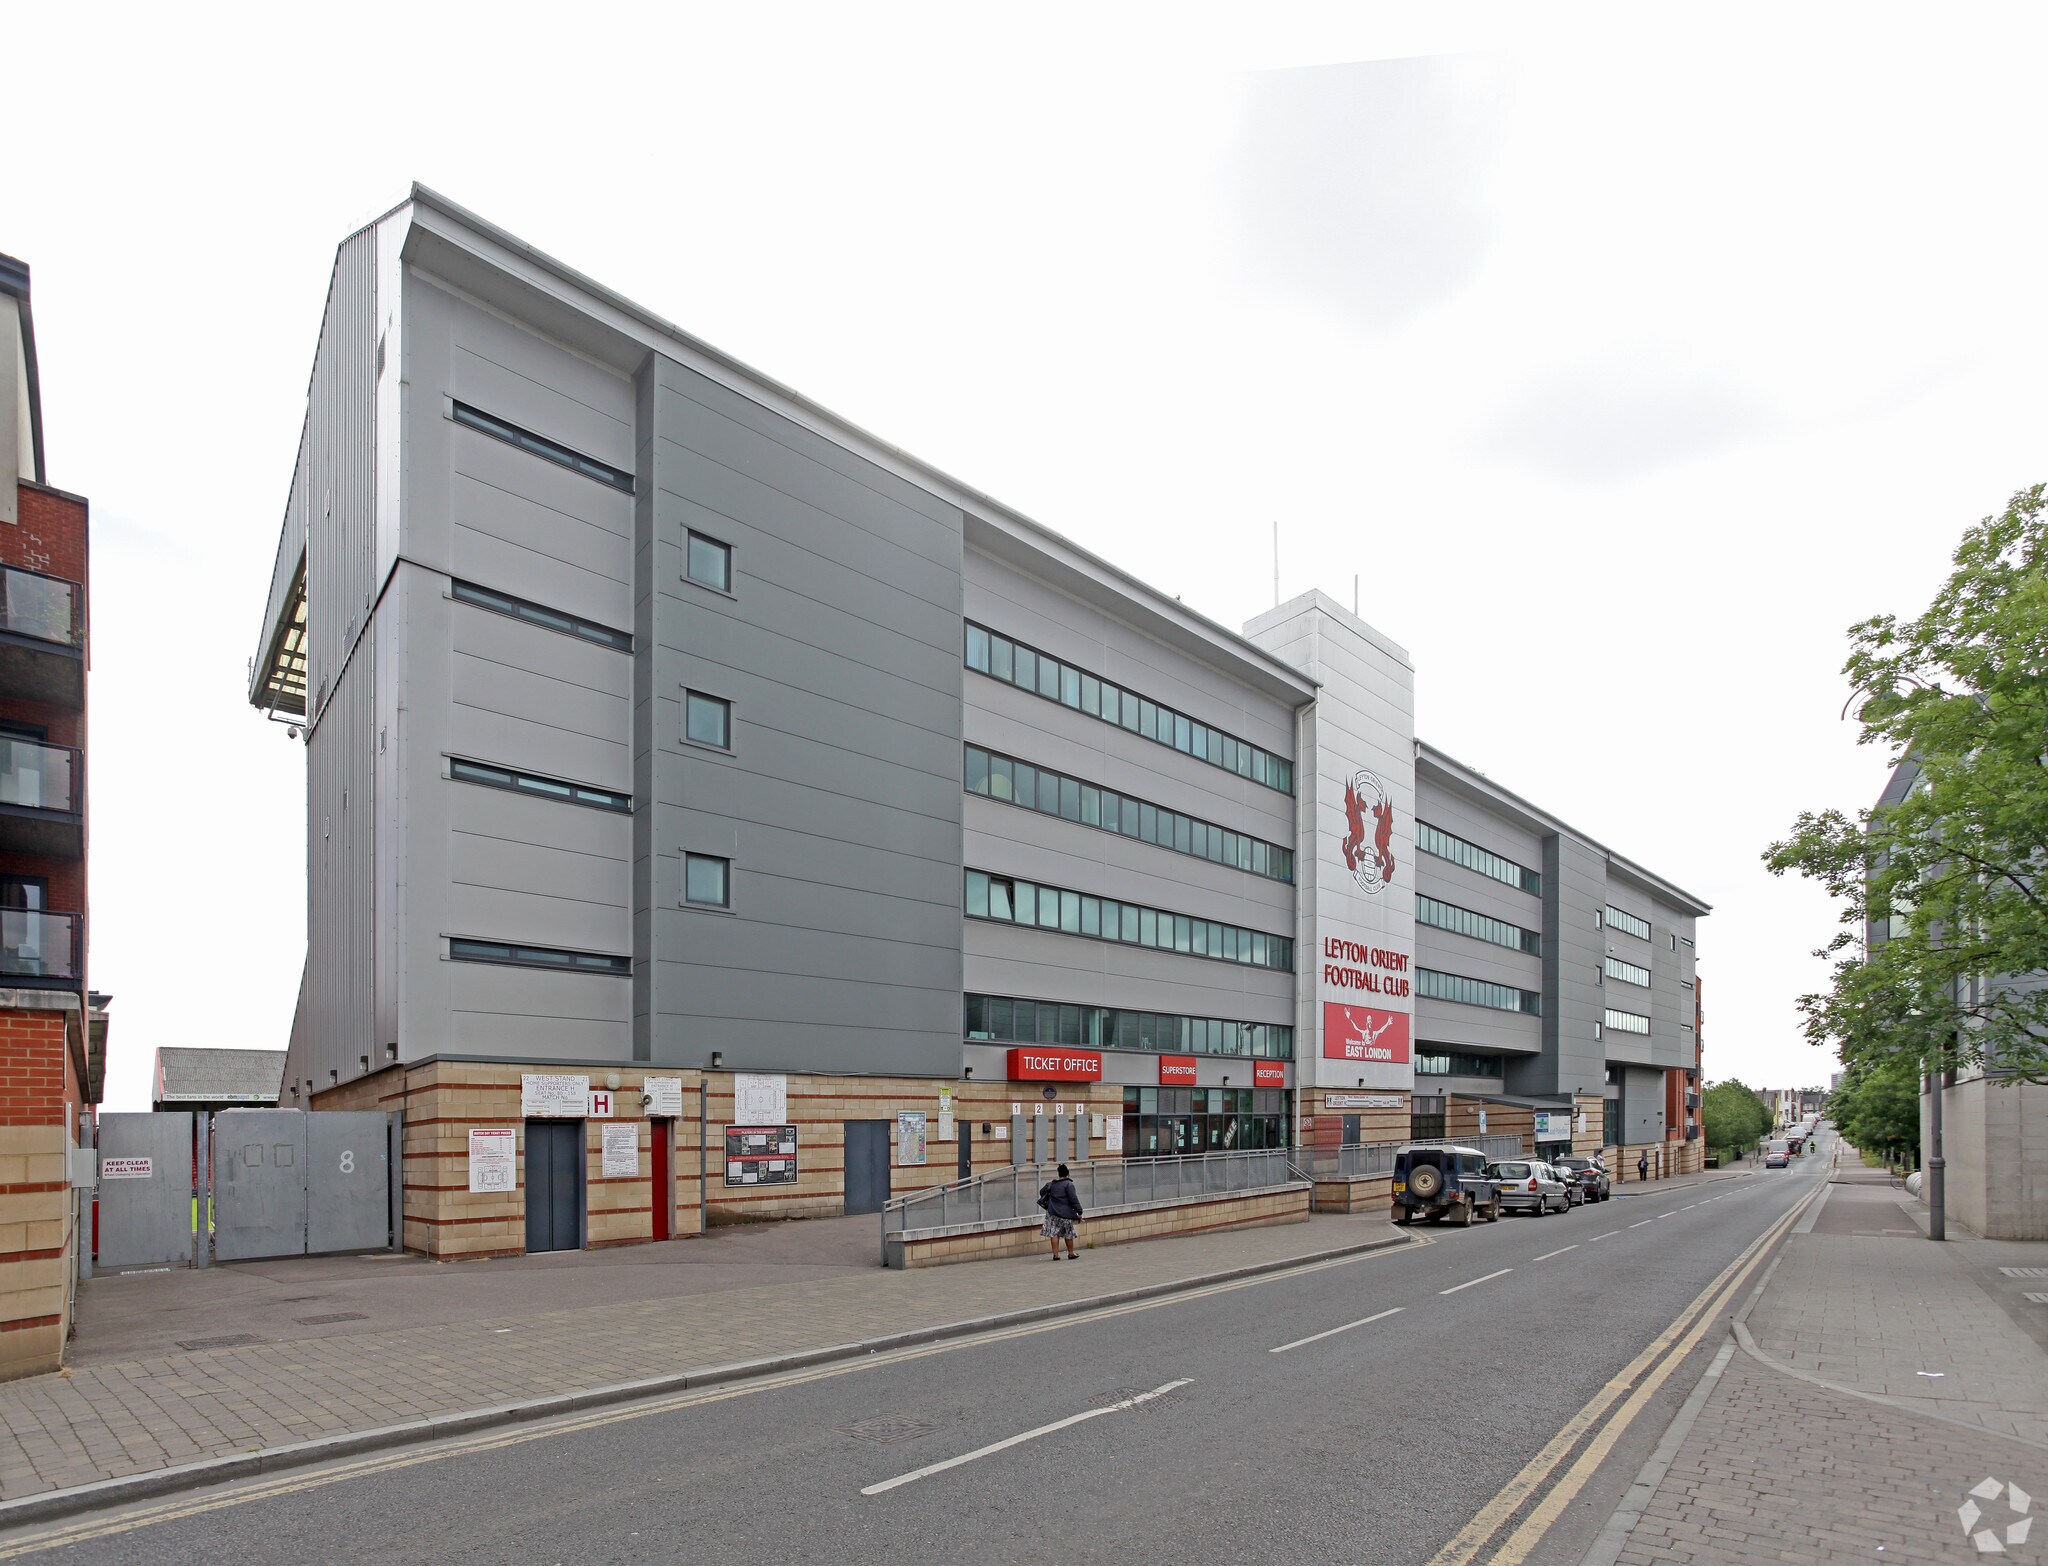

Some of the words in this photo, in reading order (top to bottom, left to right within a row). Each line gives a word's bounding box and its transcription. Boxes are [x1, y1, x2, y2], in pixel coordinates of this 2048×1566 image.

[1325, 936, 1368, 965] LEYTON
[1371, 947, 1409, 973] ORIENT
[1324, 963, 1381, 993] FOOTBALL
[1383, 975, 1409, 997] CLUB
[1345, 1038, 1361, 1046] Welcome
[1345, 1045, 1363, 1057] EAST
[1364, 1046, 1391, 1060] LONDON
[1023, 1056, 1061, 1070] TICKET
[1063, 1058, 1098, 1072] OFFICE
[1162, 1066, 1196, 1075] SUPERSTORE
[1256, 1069, 1284, 1078] RECEPTION
[594, 1094, 609, 1114] H
[1014, 1105, 1018, 1113] 1
[1036, 1105, 1041, 1113] 2
[1057, 1105, 1062, 1113] 3
[1077, 1105, 1082, 1113] 4
[1223, 1119, 1238, 1148] SALE
[339, 1149, 354, 1173] 8
